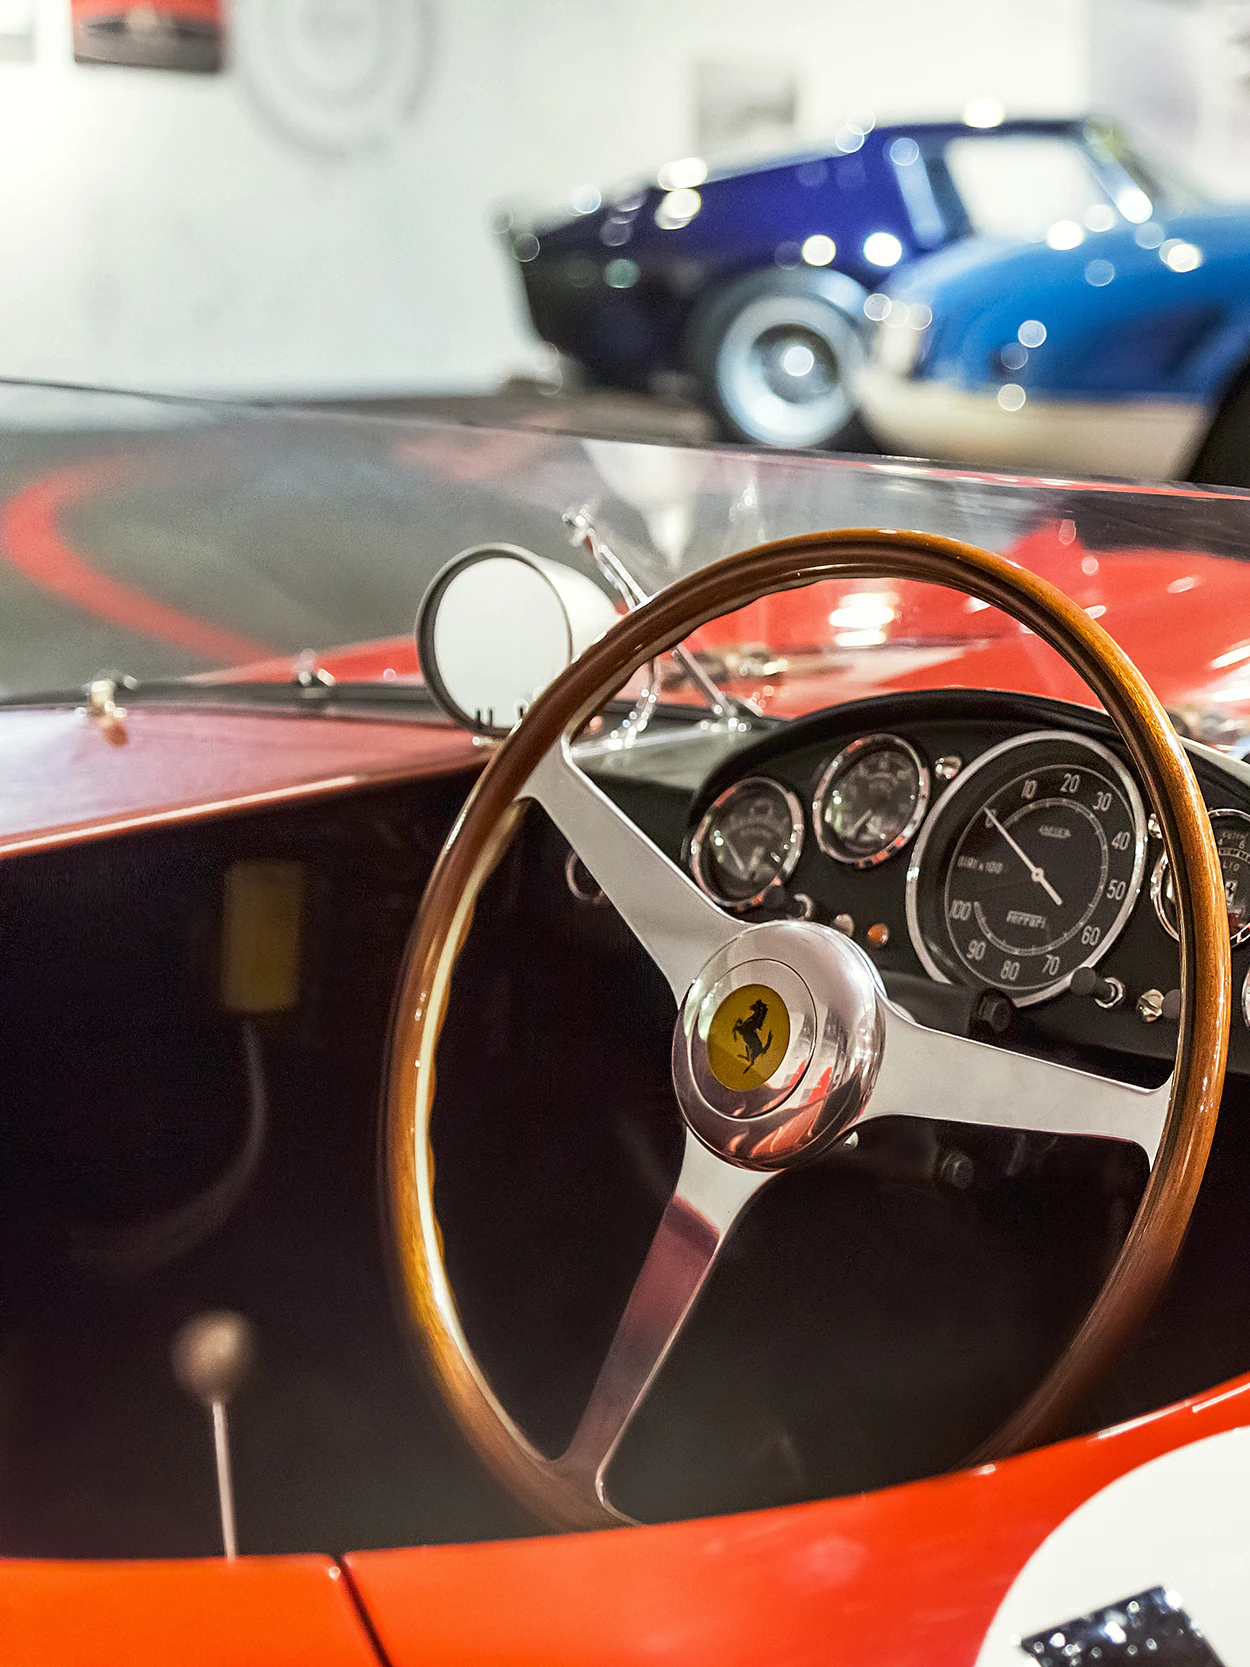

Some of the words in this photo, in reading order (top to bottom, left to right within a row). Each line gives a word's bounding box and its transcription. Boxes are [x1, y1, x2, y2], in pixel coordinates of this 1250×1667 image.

[1020, 779, 1039, 800] 10
[1060, 773, 1081, 794] 20
[1092, 791, 1113, 812] 30
[1111, 831, 1131, 852] 40
[1238, 839, 1246, 850] 6
[1107, 879, 1127, 901] 50
[949, 899, 973, 922] 100
[1081, 924, 1102, 946] 60
[966, 939, 988, 961] 90
[999, 959, 1021, 982] 80
[1041, 954, 1061, 976] 70
